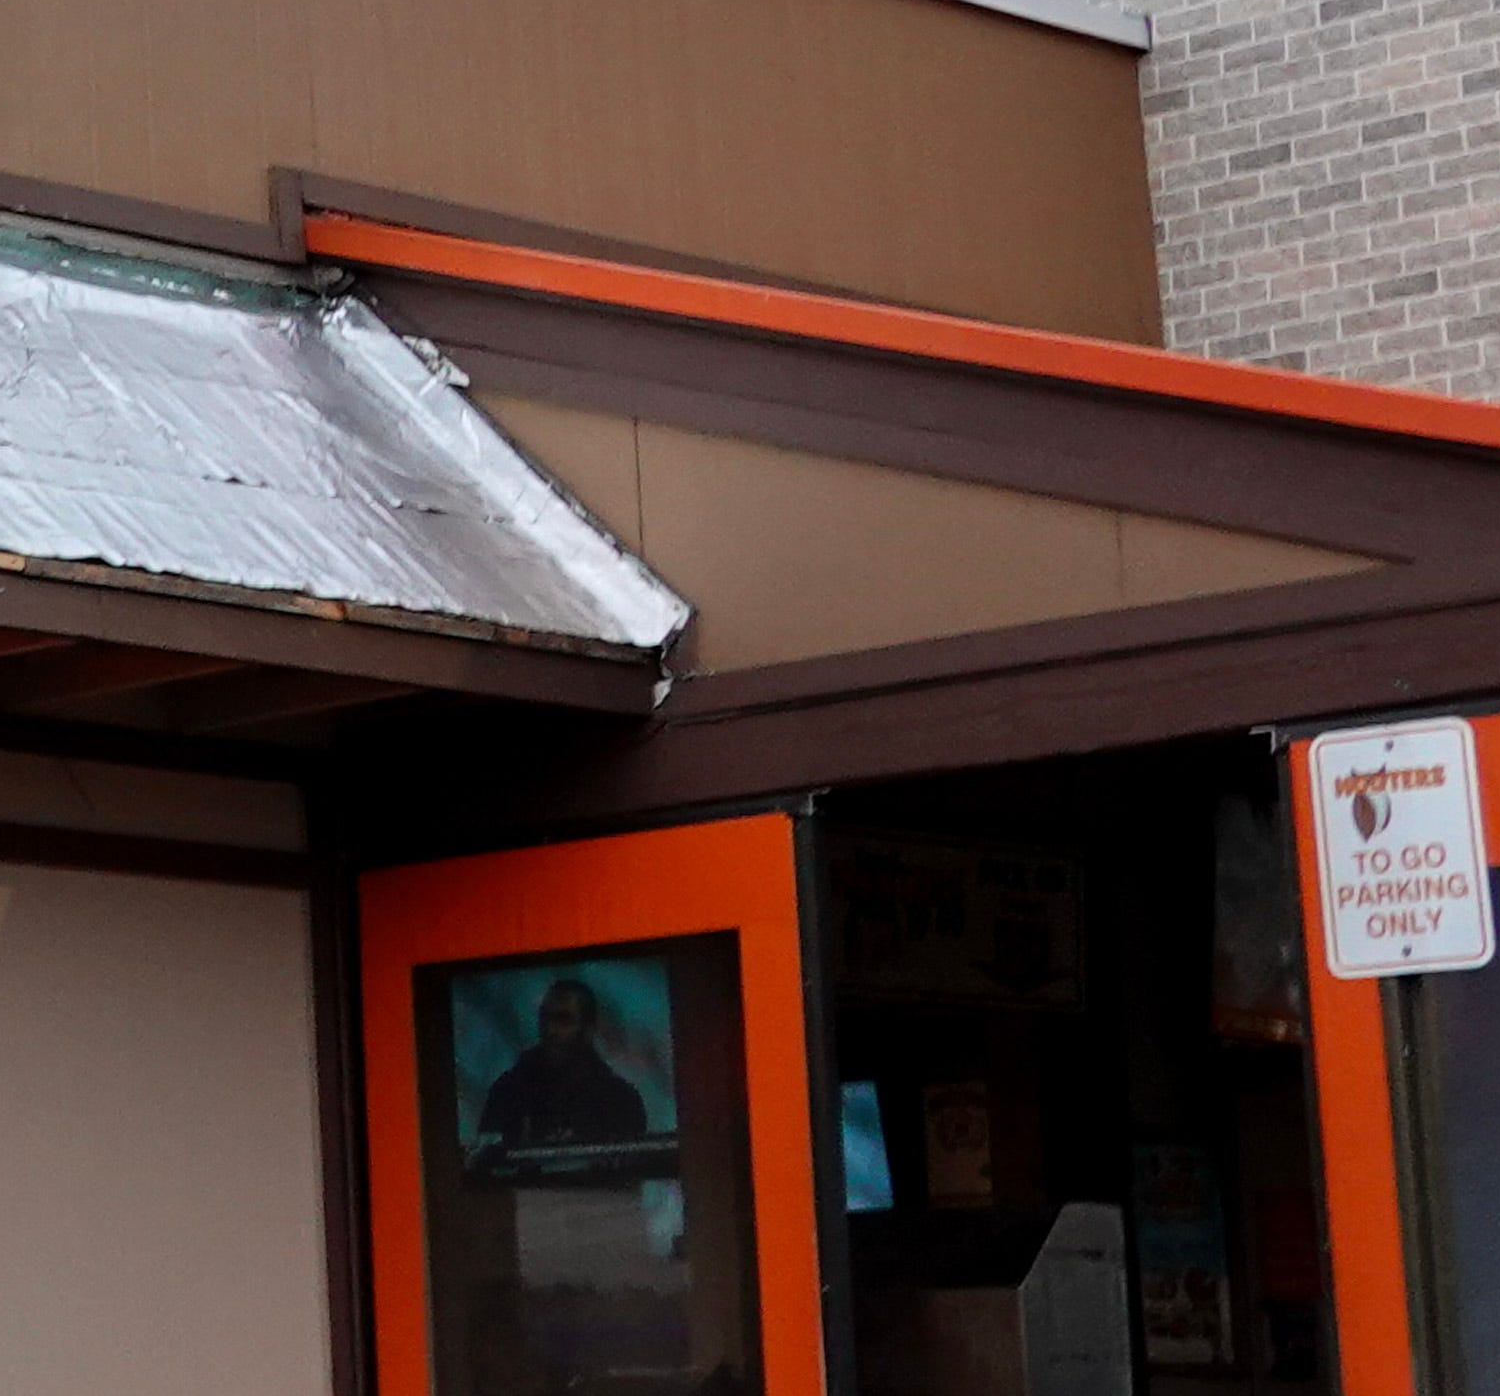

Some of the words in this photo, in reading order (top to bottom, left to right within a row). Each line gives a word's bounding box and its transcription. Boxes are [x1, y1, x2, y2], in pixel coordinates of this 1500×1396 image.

[1335, 766, 1446, 797] HOOTERS
[1352, 849, 1392, 876] TO
[1401, 842, 1447, 871] GO
[1337, 873, 1469, 910] PARKING
[1365, 907, 1443, 939] ONLY
